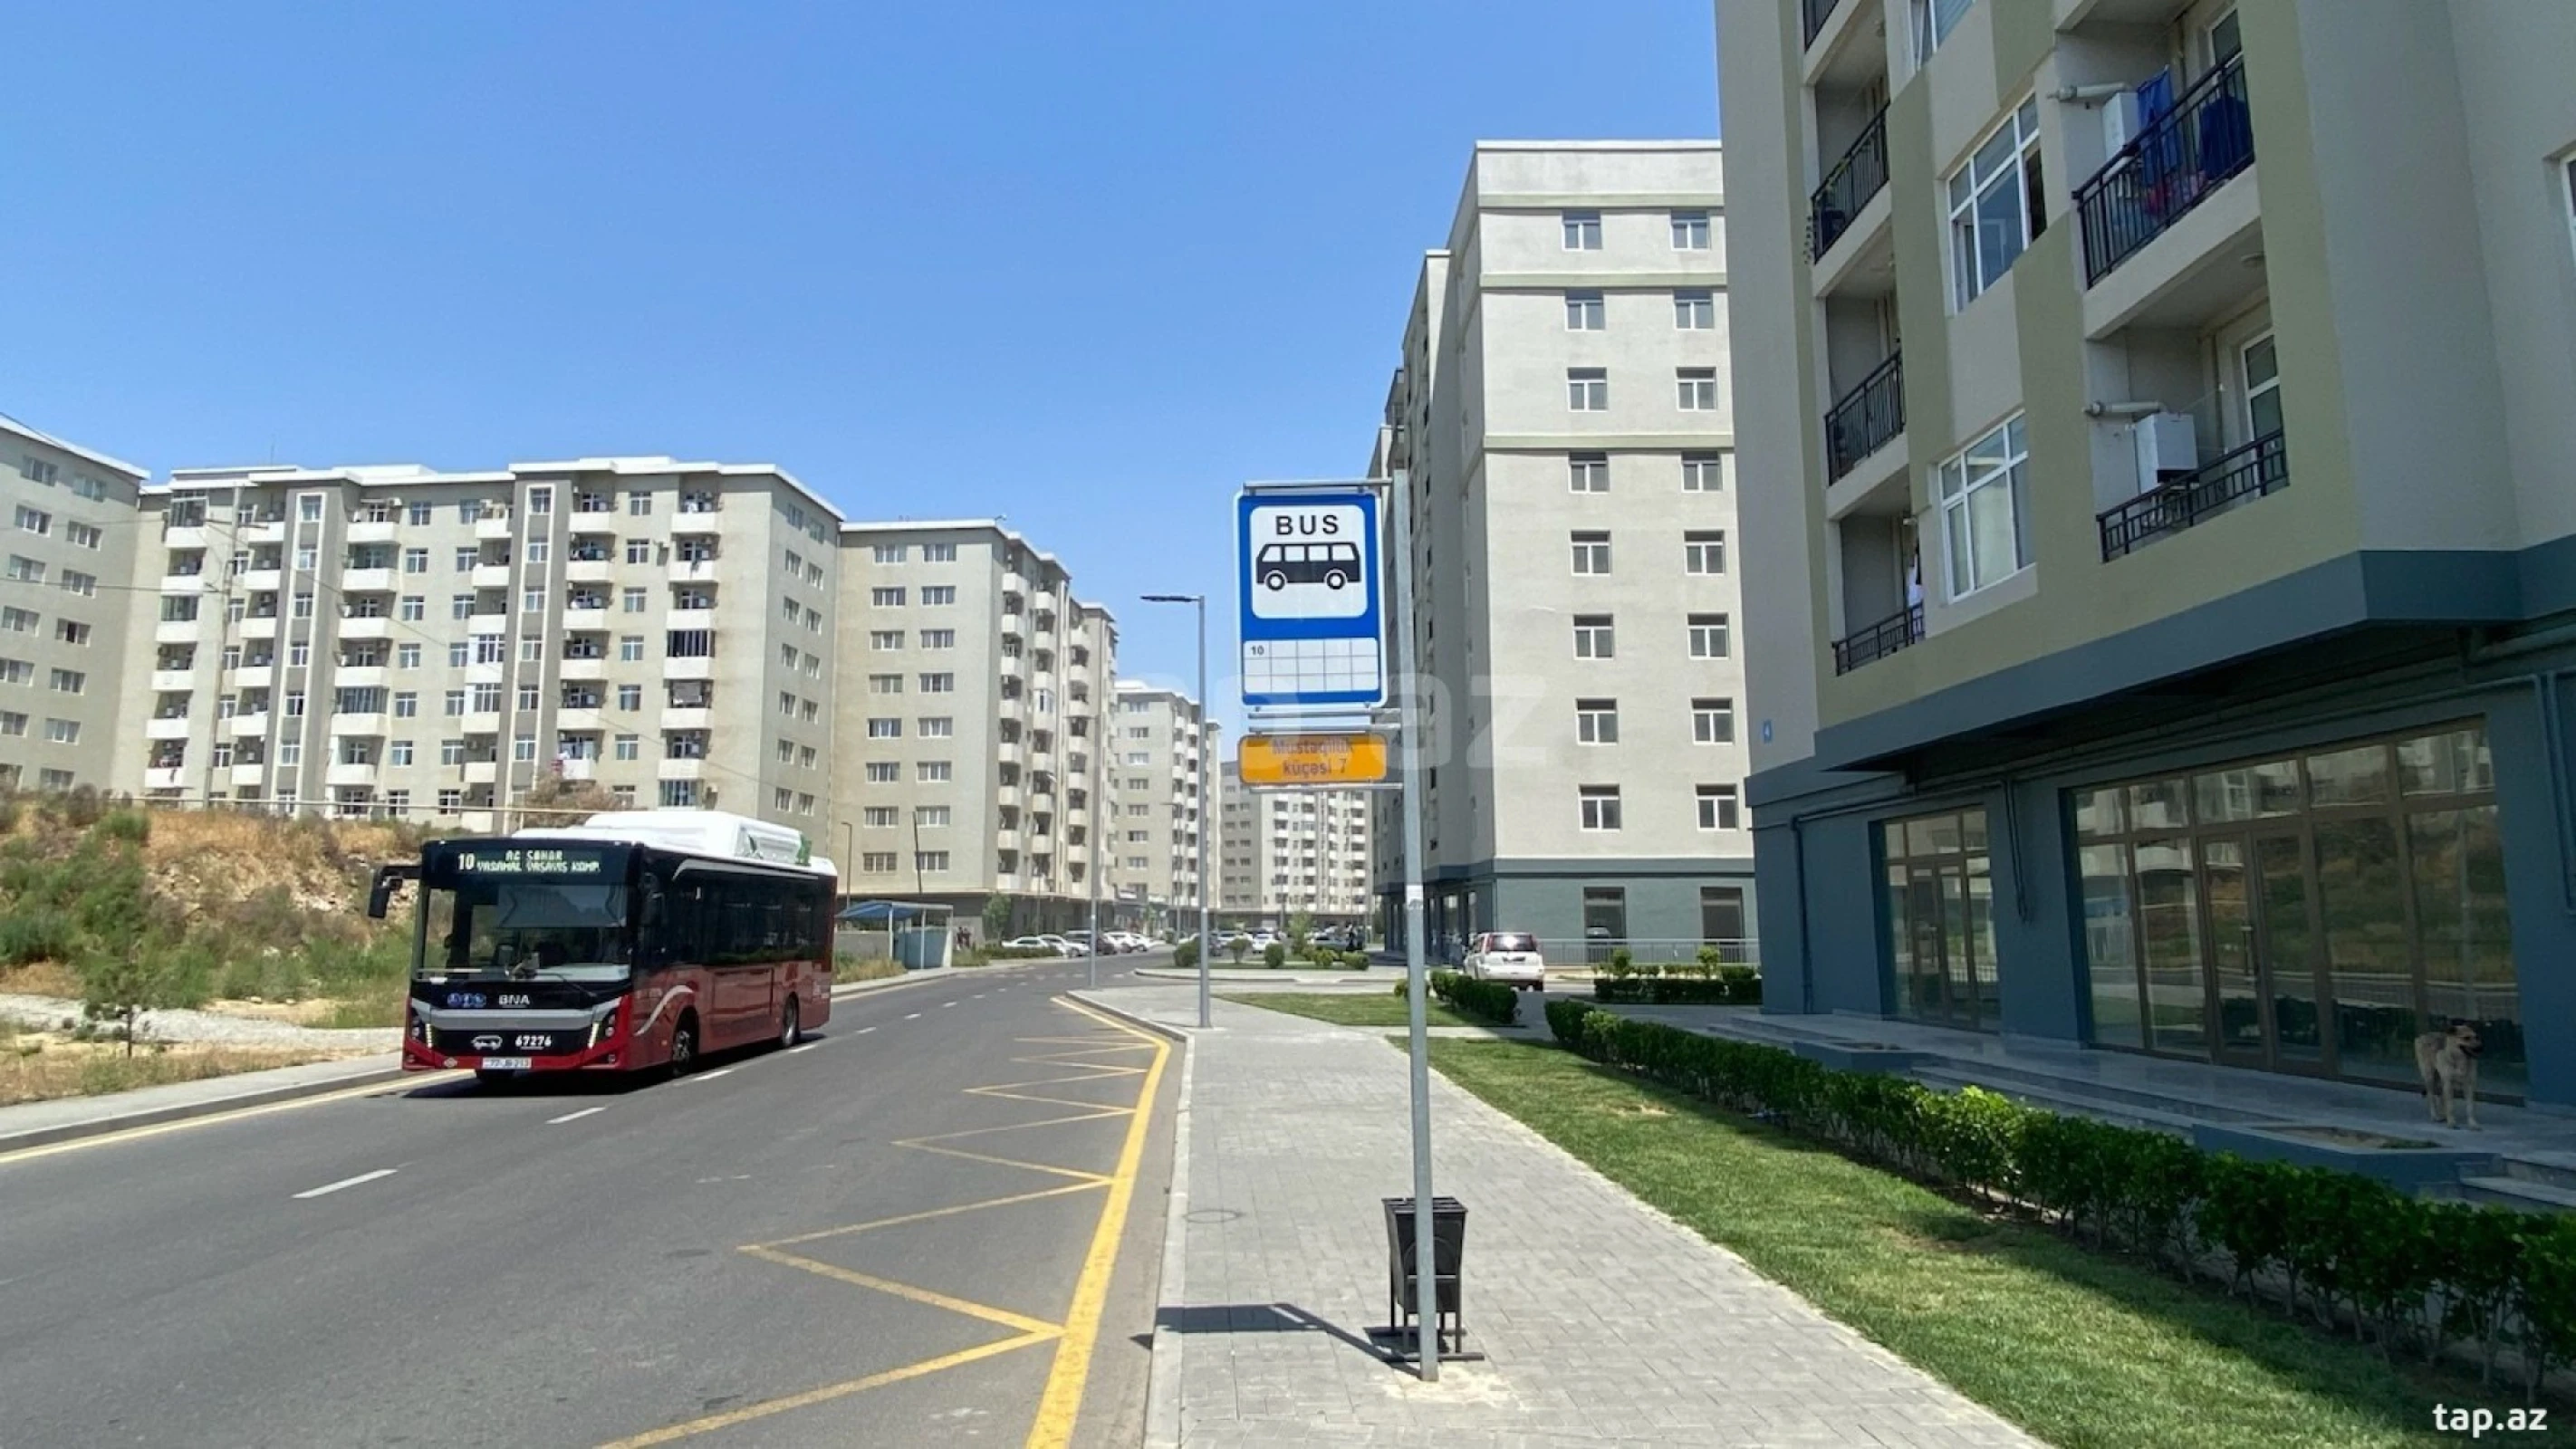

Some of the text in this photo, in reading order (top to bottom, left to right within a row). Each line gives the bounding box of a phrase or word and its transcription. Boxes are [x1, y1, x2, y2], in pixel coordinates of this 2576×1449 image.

[1275, 514, 1340, 535] BUS
[1250, 646, 1264, 655] 10
[1339, 758, 1347, 773] 7
[457, 852, 476, 870] 10
[498, 994, 531, 1005] BNA
[514, 1035, 552, 1047] 67276
